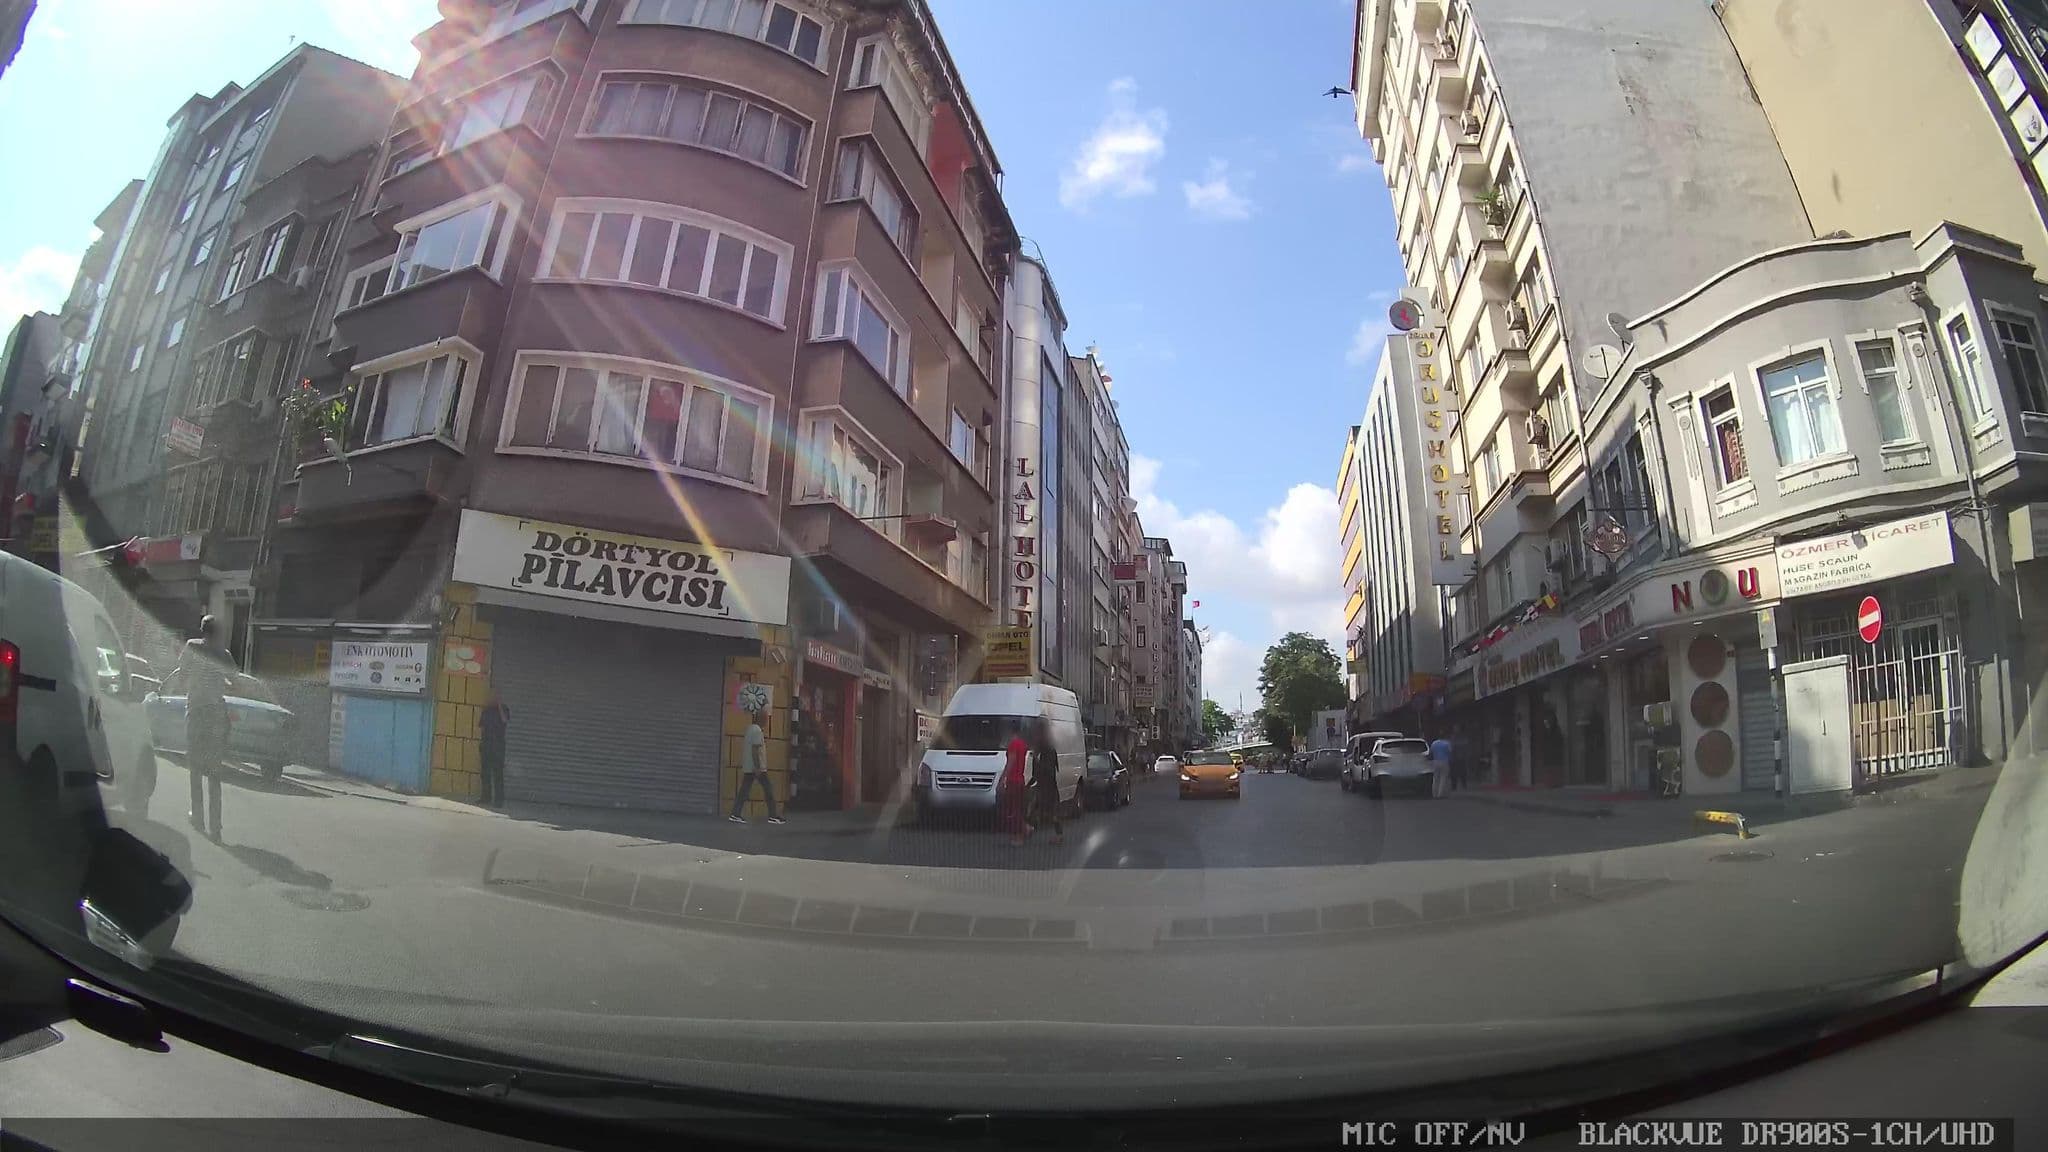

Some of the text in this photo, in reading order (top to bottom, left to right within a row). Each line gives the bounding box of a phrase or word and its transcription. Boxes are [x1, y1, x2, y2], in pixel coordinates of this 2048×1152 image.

[1427, 439, 1455, 561] HOTEL
[532, 530, 719, 576] DÖRTYOL
[1012, 457, 1036, 628] LAL HOTE
[1864, 516, 1943, 541] ICARET
[518, 552, 728, 611] PİLAVCISI
[1783, 554, 1858, 575] HUSE SCAUN
